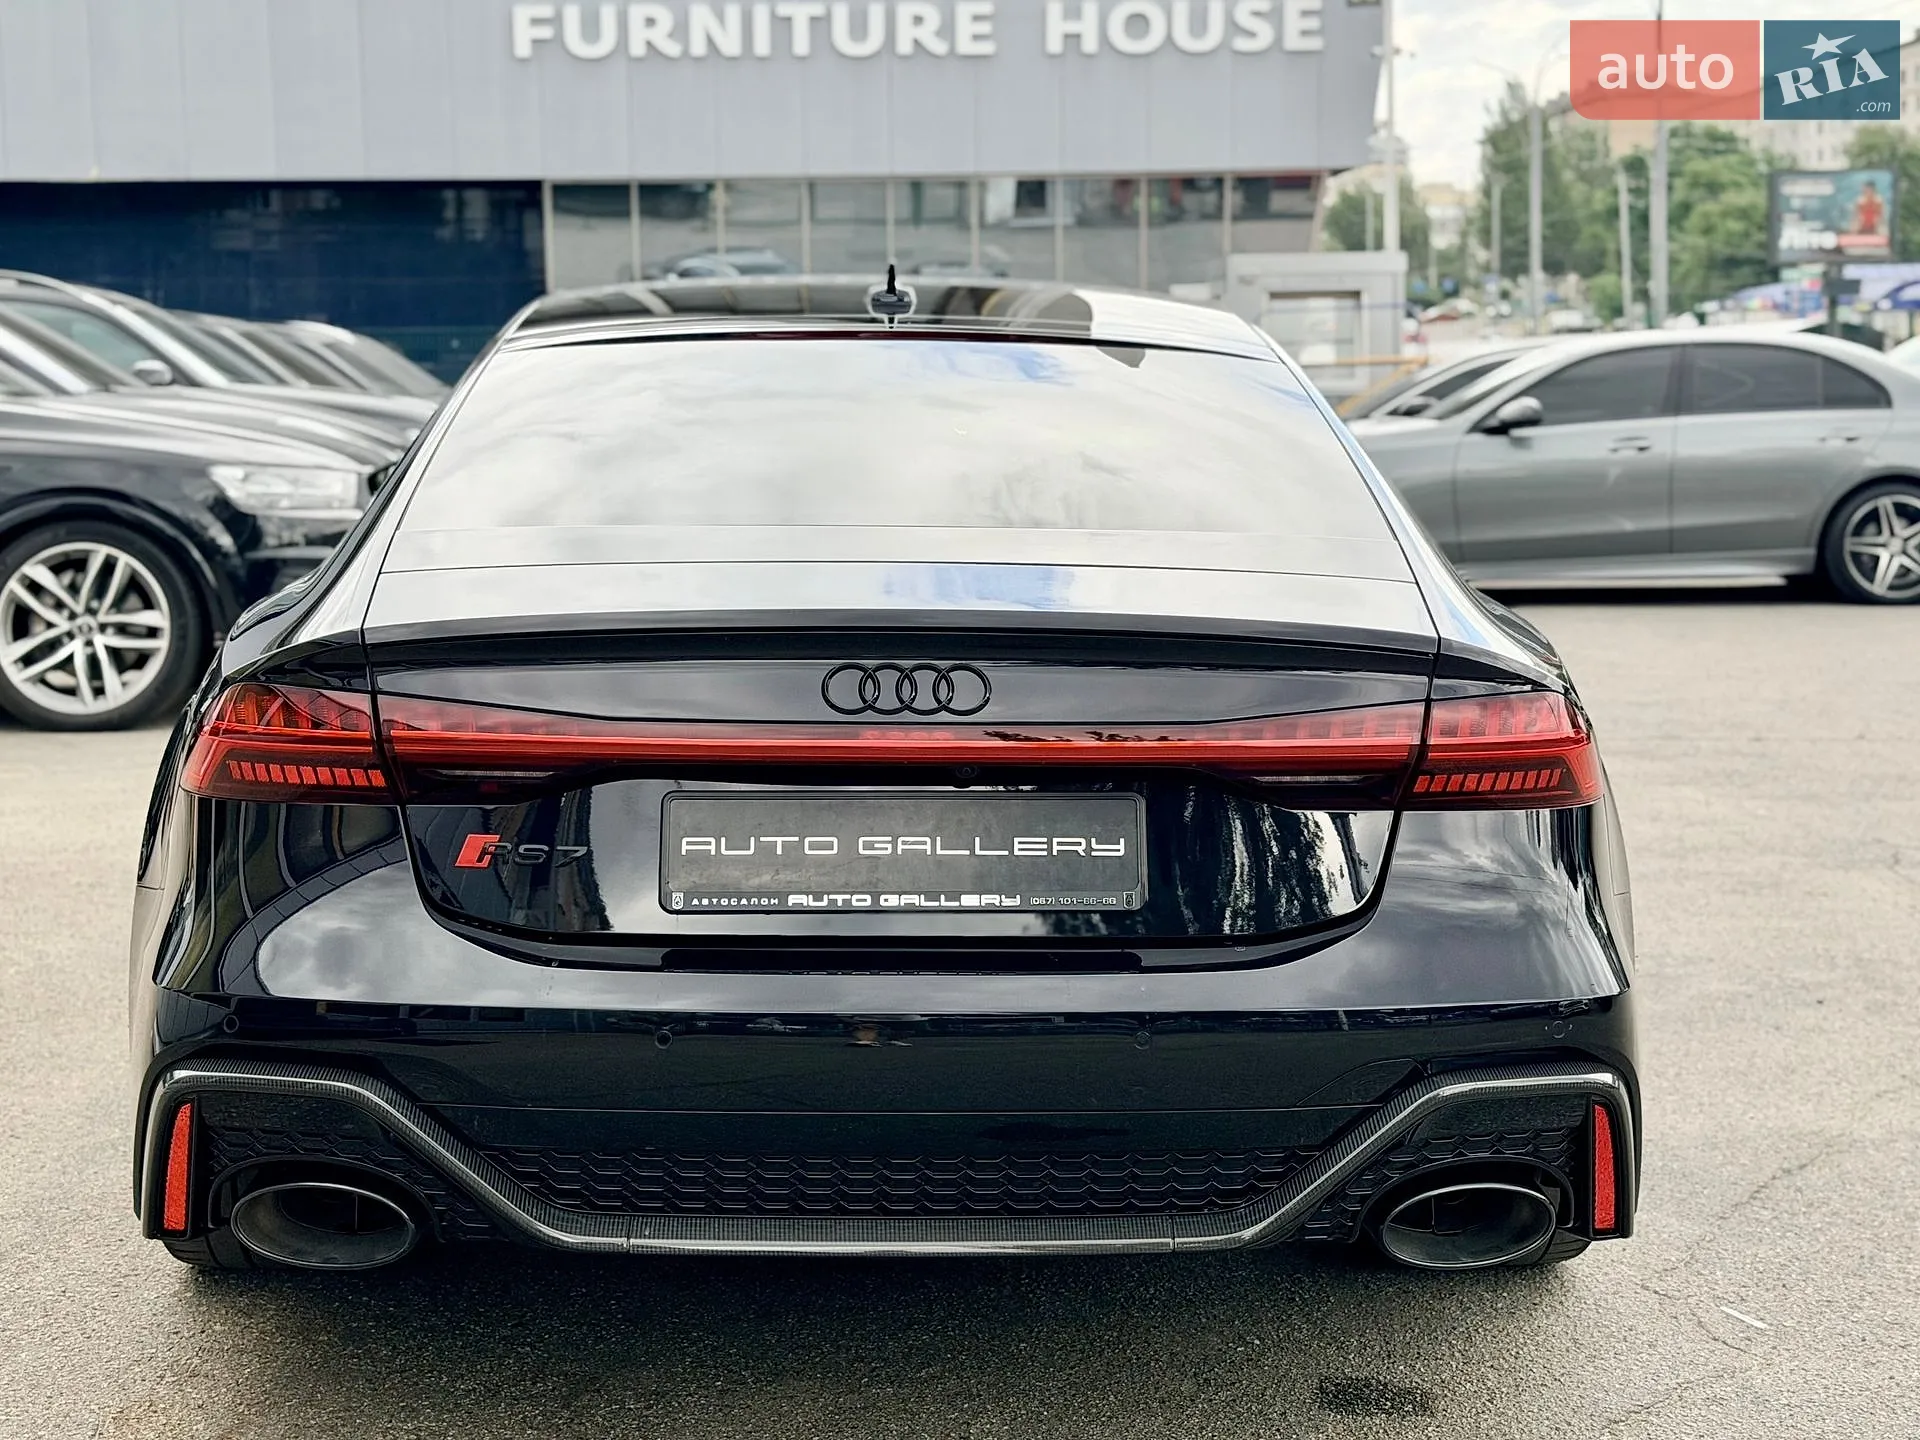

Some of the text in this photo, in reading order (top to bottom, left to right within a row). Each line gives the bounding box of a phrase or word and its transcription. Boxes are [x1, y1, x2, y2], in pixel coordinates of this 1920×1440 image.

[511, 0, 1325, 58] FURNITURE HOUSE
[681, 836, 1125, 857] AUTO GALLERY
[691, 897, 779, 906] АВТОСАЛОН
[787, 894, 872, 907] AUTO
[879, 894, 1021, 907] GALLERY
